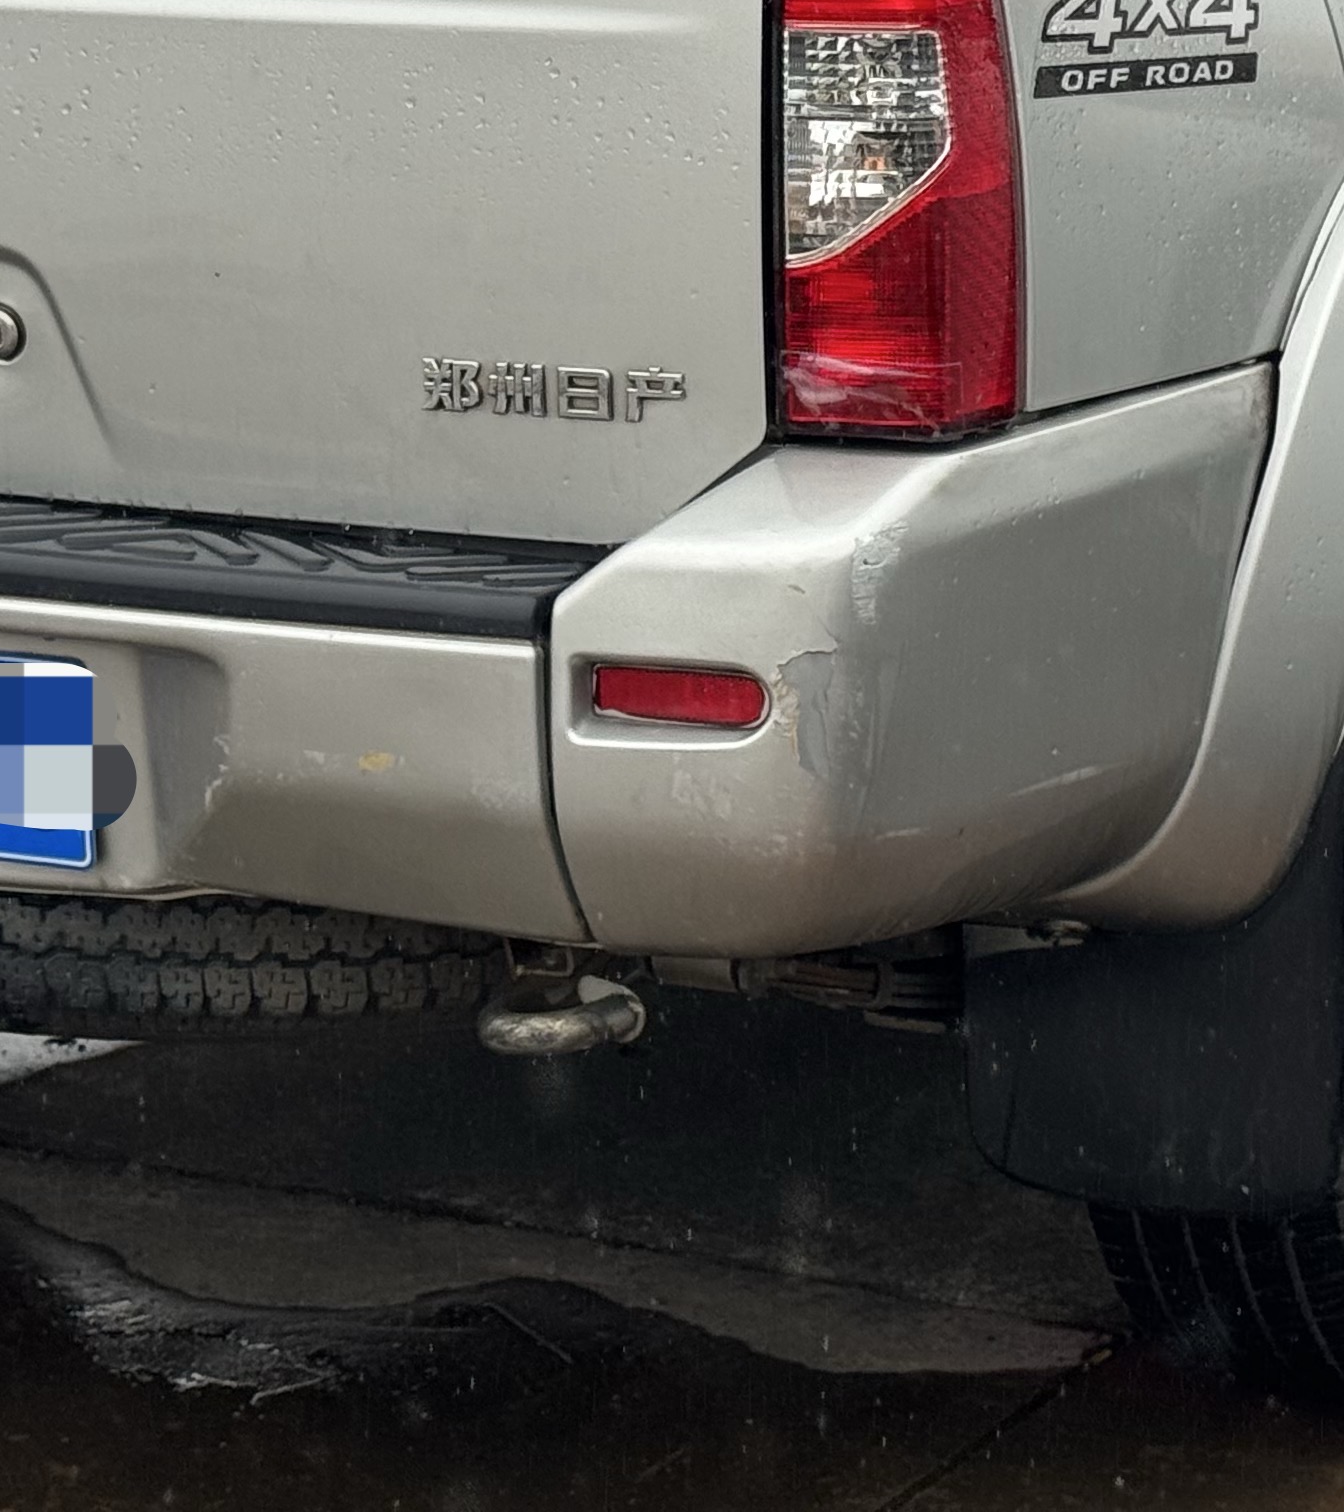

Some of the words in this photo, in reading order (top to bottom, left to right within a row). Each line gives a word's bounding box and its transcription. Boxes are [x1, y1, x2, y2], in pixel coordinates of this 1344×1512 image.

[1061, 67, 1131, 92] OFF
[1145, 59, 1235, 87] ROAD
[421, 356, 687, 424] 郑州日产
